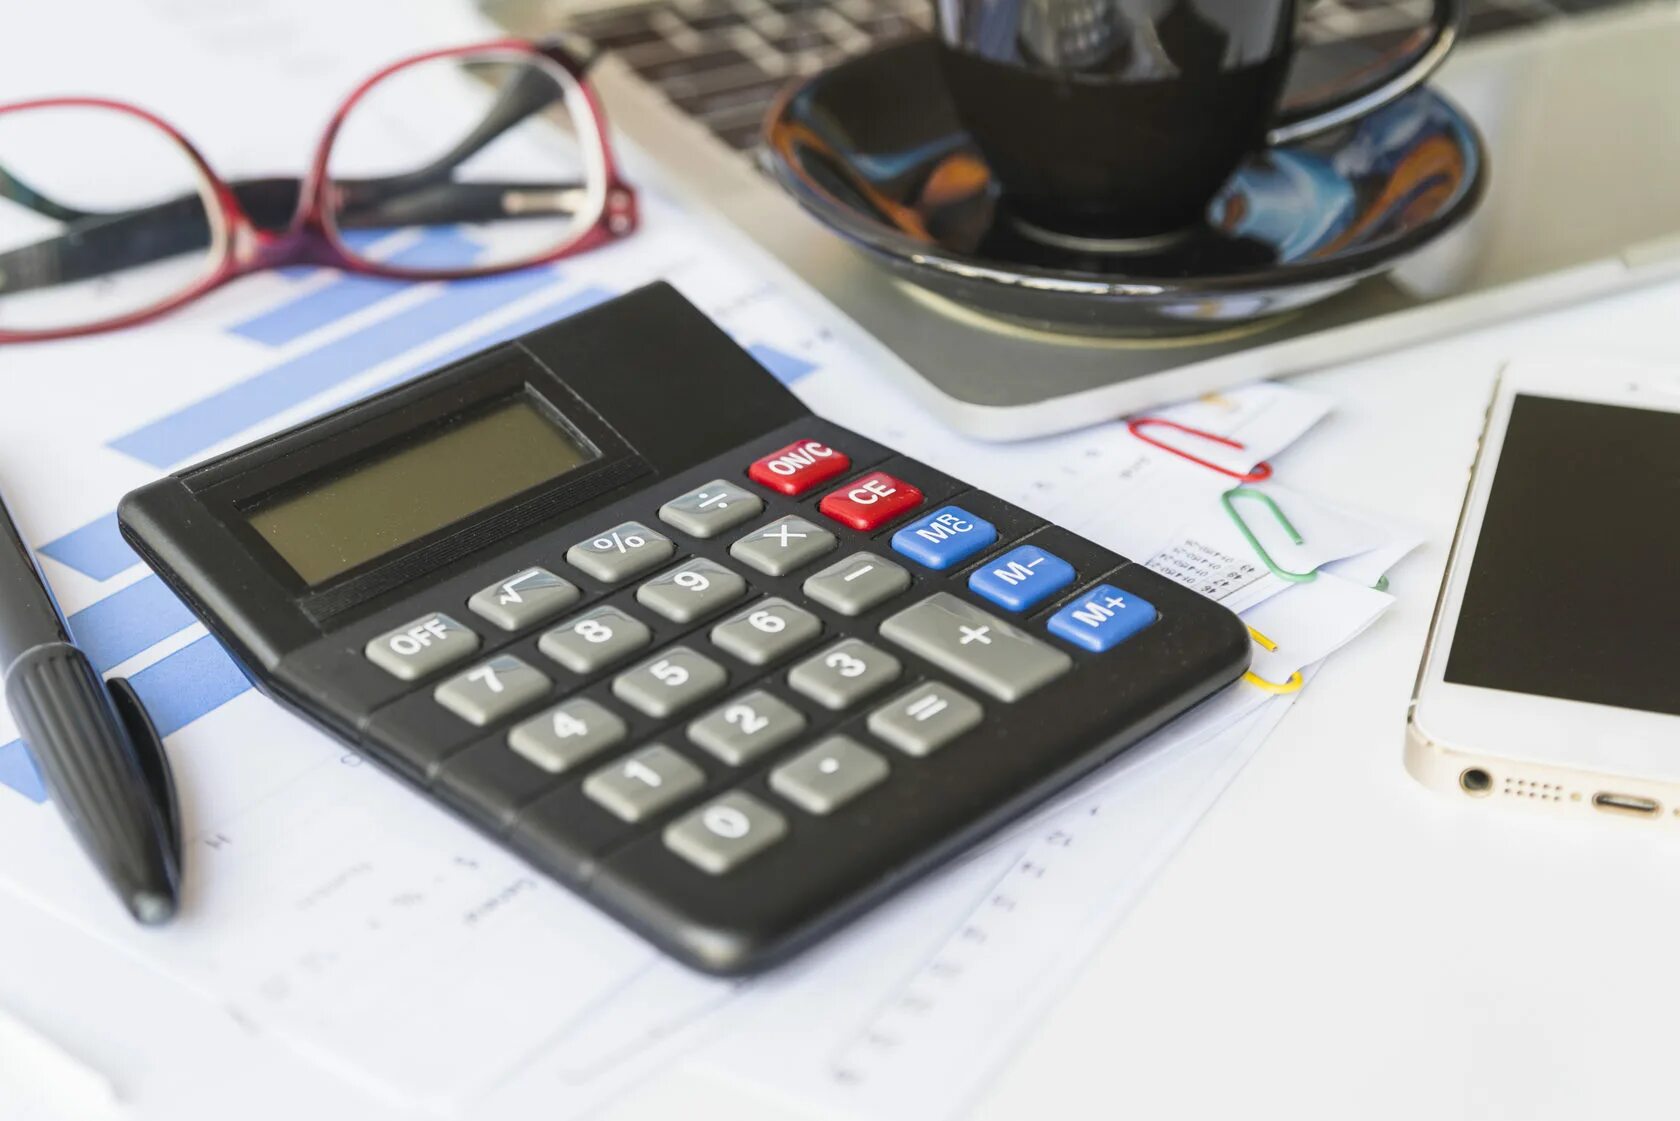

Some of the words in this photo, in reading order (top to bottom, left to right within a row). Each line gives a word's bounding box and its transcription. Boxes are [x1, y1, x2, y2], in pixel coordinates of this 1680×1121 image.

[768, 440, 834, 477] ON/C
[847, 479, 897, 506] CE
[592, 531, 645, 555] %
[673, 570, 711, 593] 9
[748, 611, 786, 634] 6
[1071, 593, 1127, 628] M+
[389, 617, 450, 656] OFF
[573, 618, 613, 643] 8
[648, 658, 690, 686] 5
[825, 651, 867, 678] 3
[467, 666, 505, 693] 7
[551, 710, 589, 740] 4
[723, 704, 770, 736] 2
[622, 760, 663, 788] 1
[702, 803, 751, 839] 0
